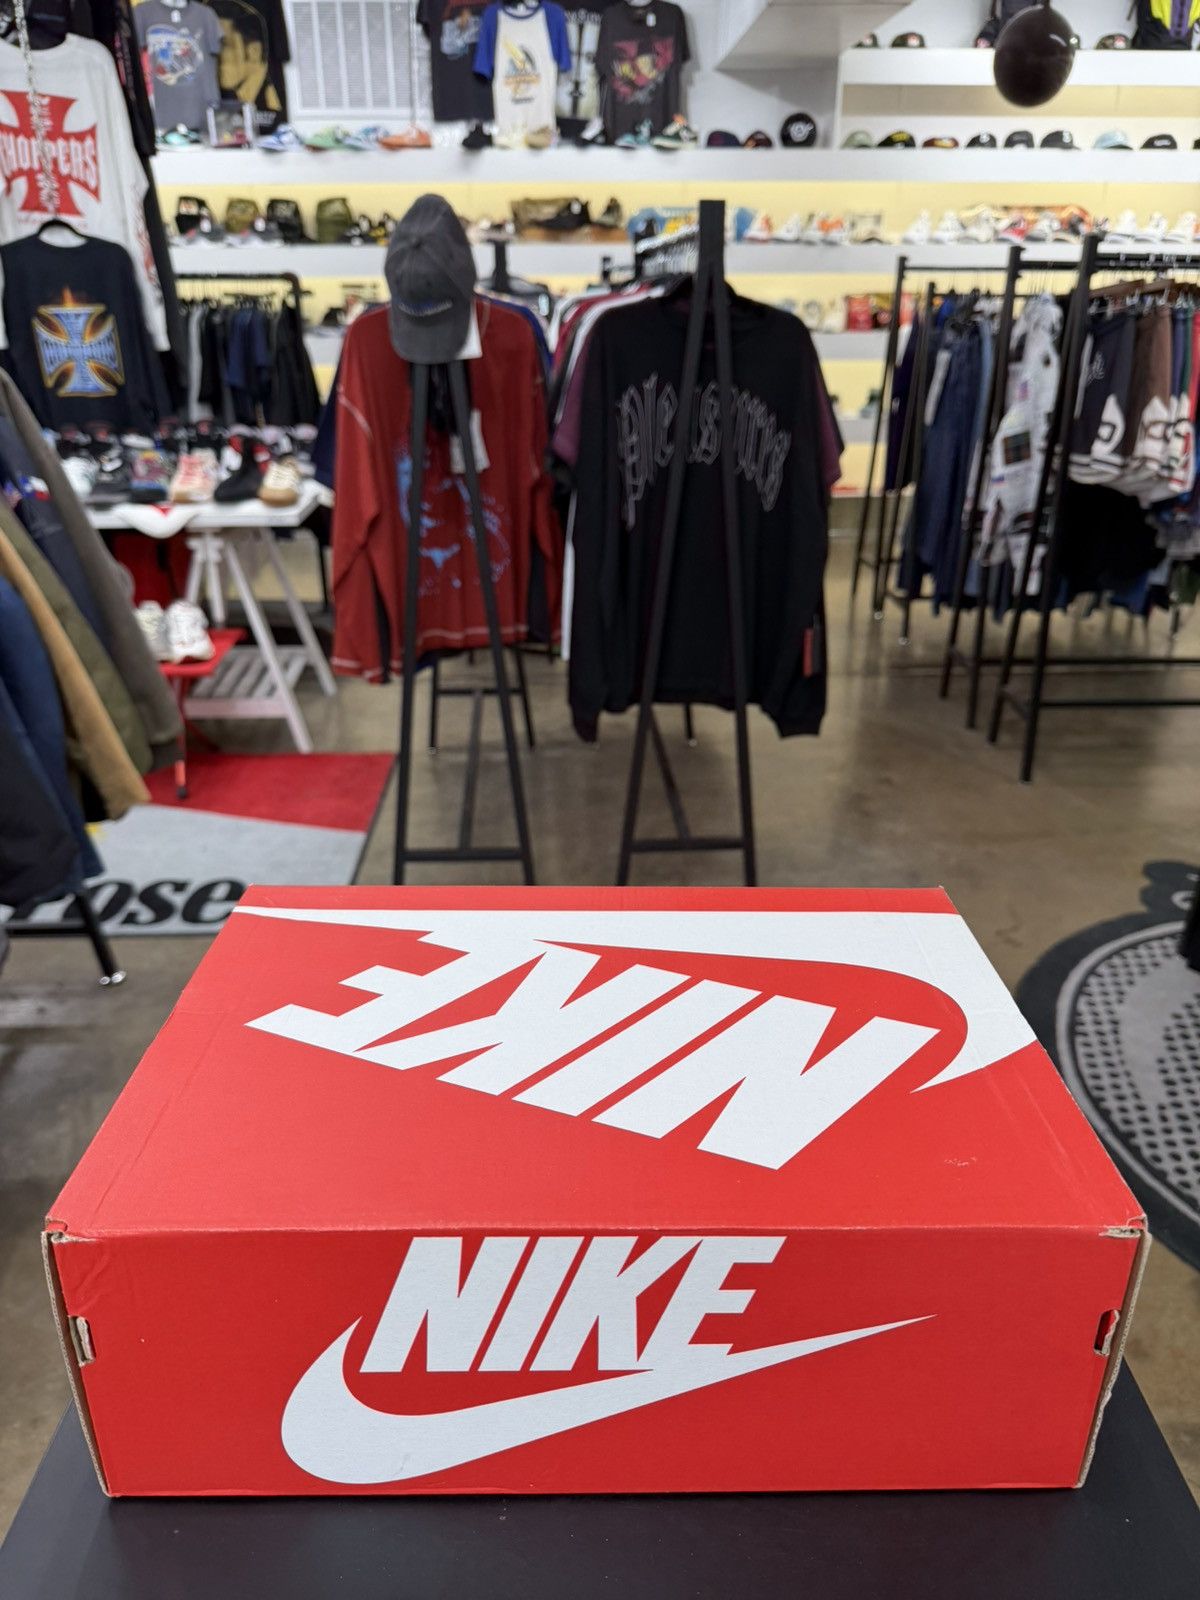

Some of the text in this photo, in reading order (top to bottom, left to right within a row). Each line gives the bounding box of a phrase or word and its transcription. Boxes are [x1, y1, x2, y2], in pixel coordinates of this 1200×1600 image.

[0, 130, 98, 191] HOPPERS
[244, 930, 941, 1170] NIKE
[360, 1235, 787, 1373] NIKE
